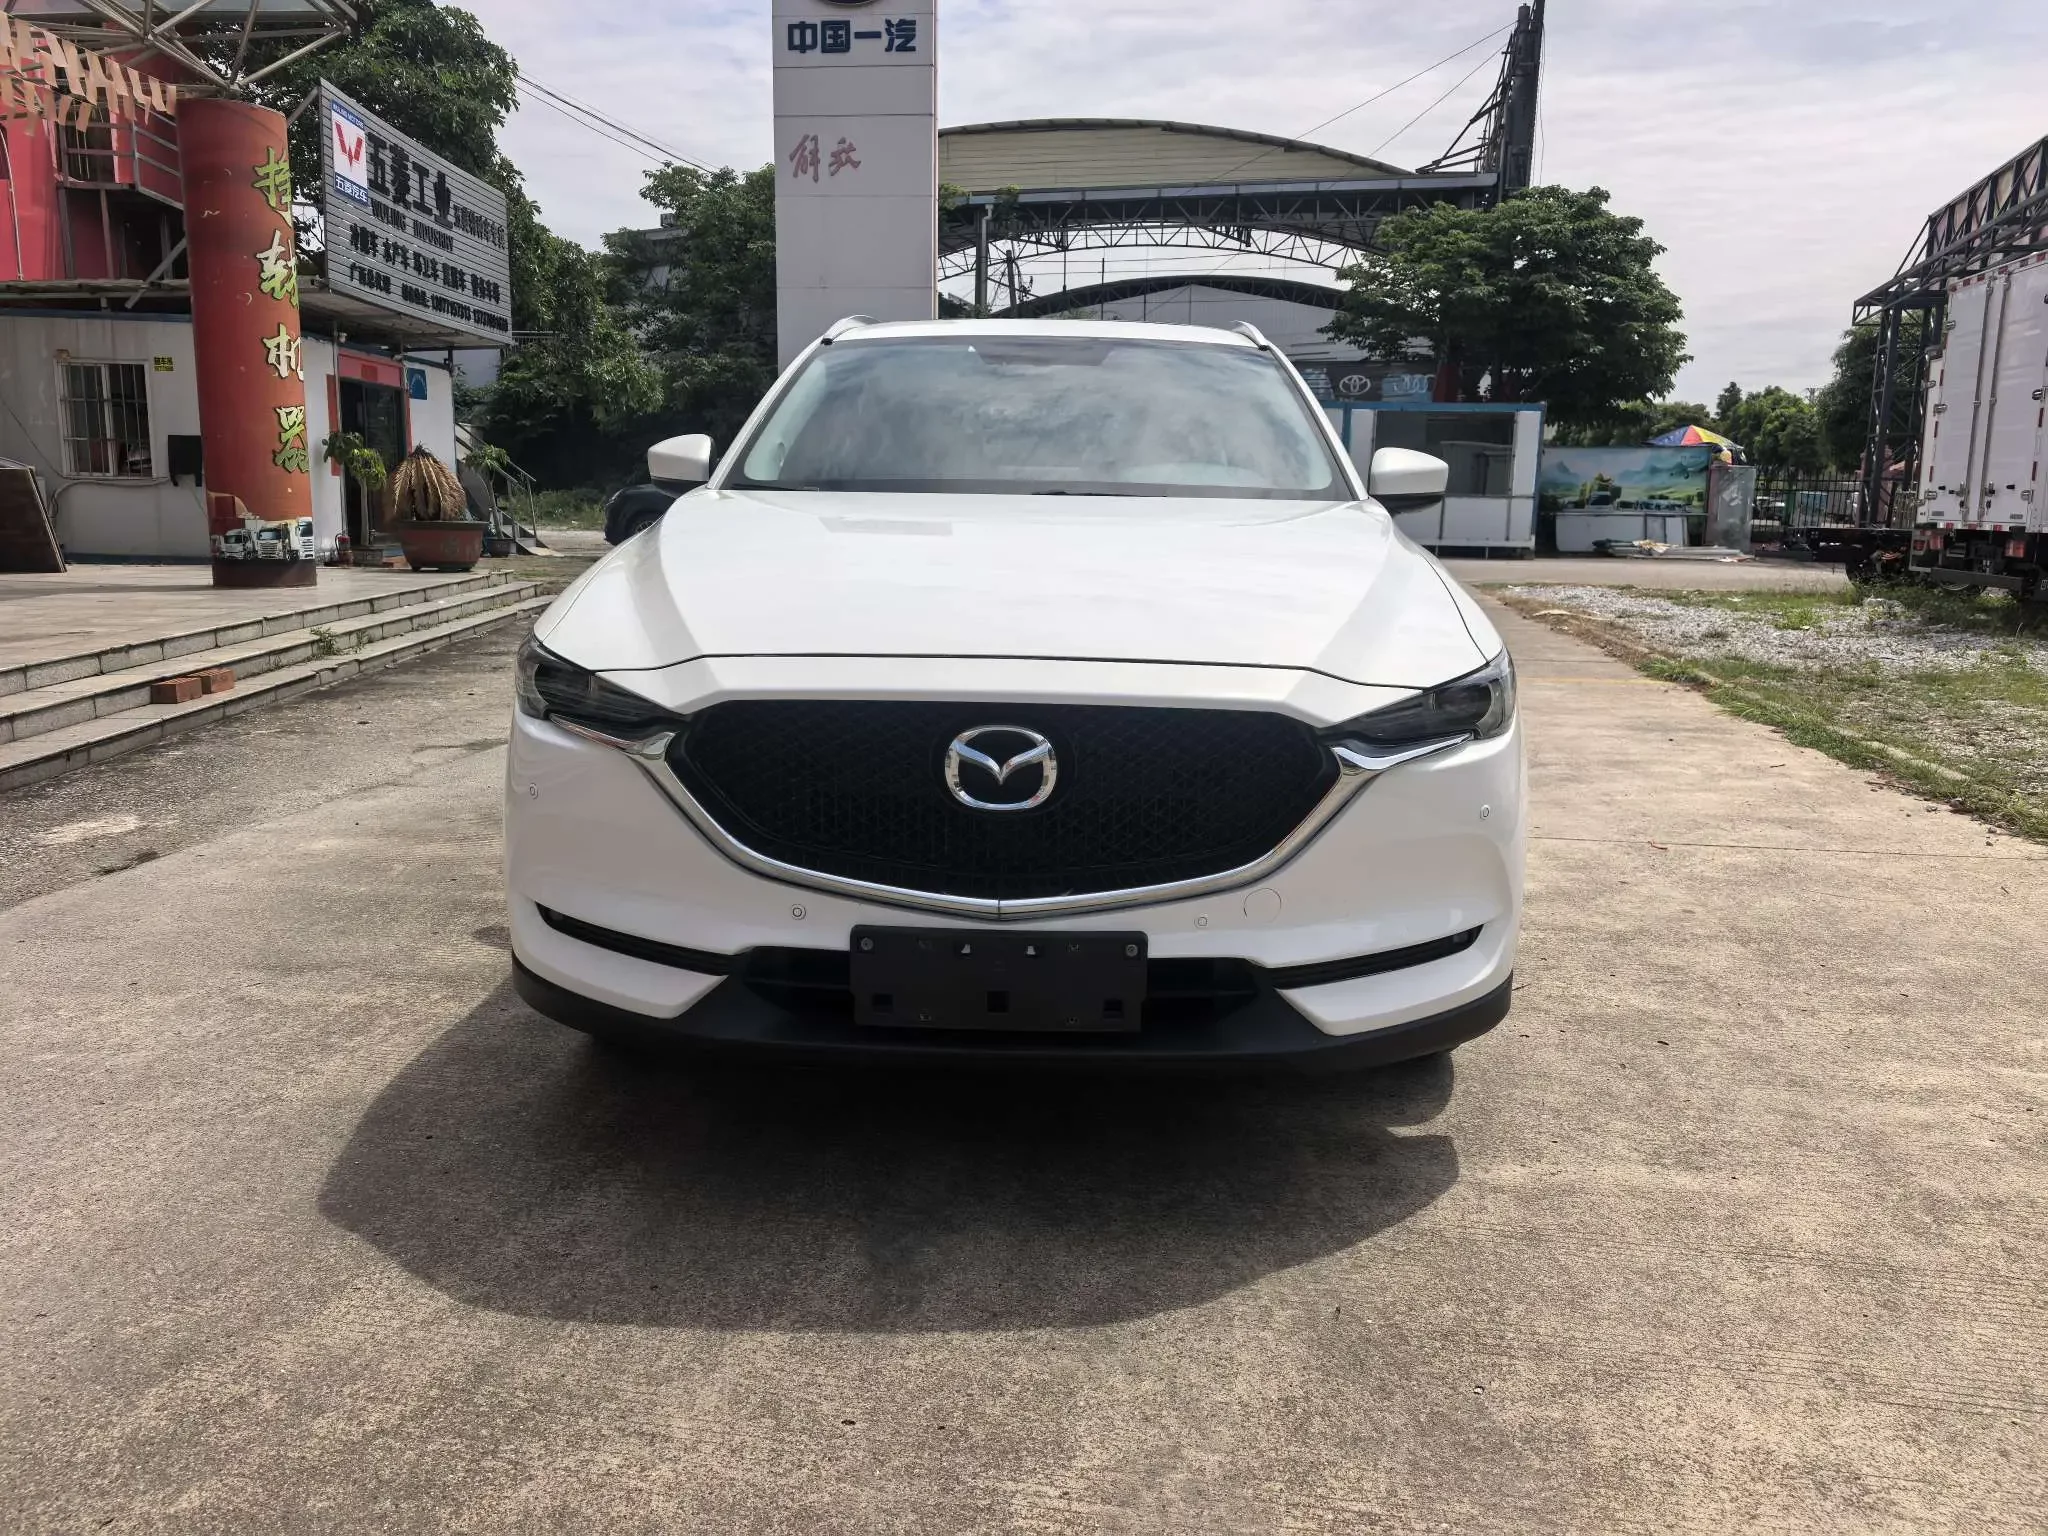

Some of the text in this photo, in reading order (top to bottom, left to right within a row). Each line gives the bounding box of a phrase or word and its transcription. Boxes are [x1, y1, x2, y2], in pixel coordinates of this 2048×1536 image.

[788, 19, 917, 53] 中国一汽
[335, 175, 368, 203] 五菱汽车
[371, 198, 407, 231] WULING
